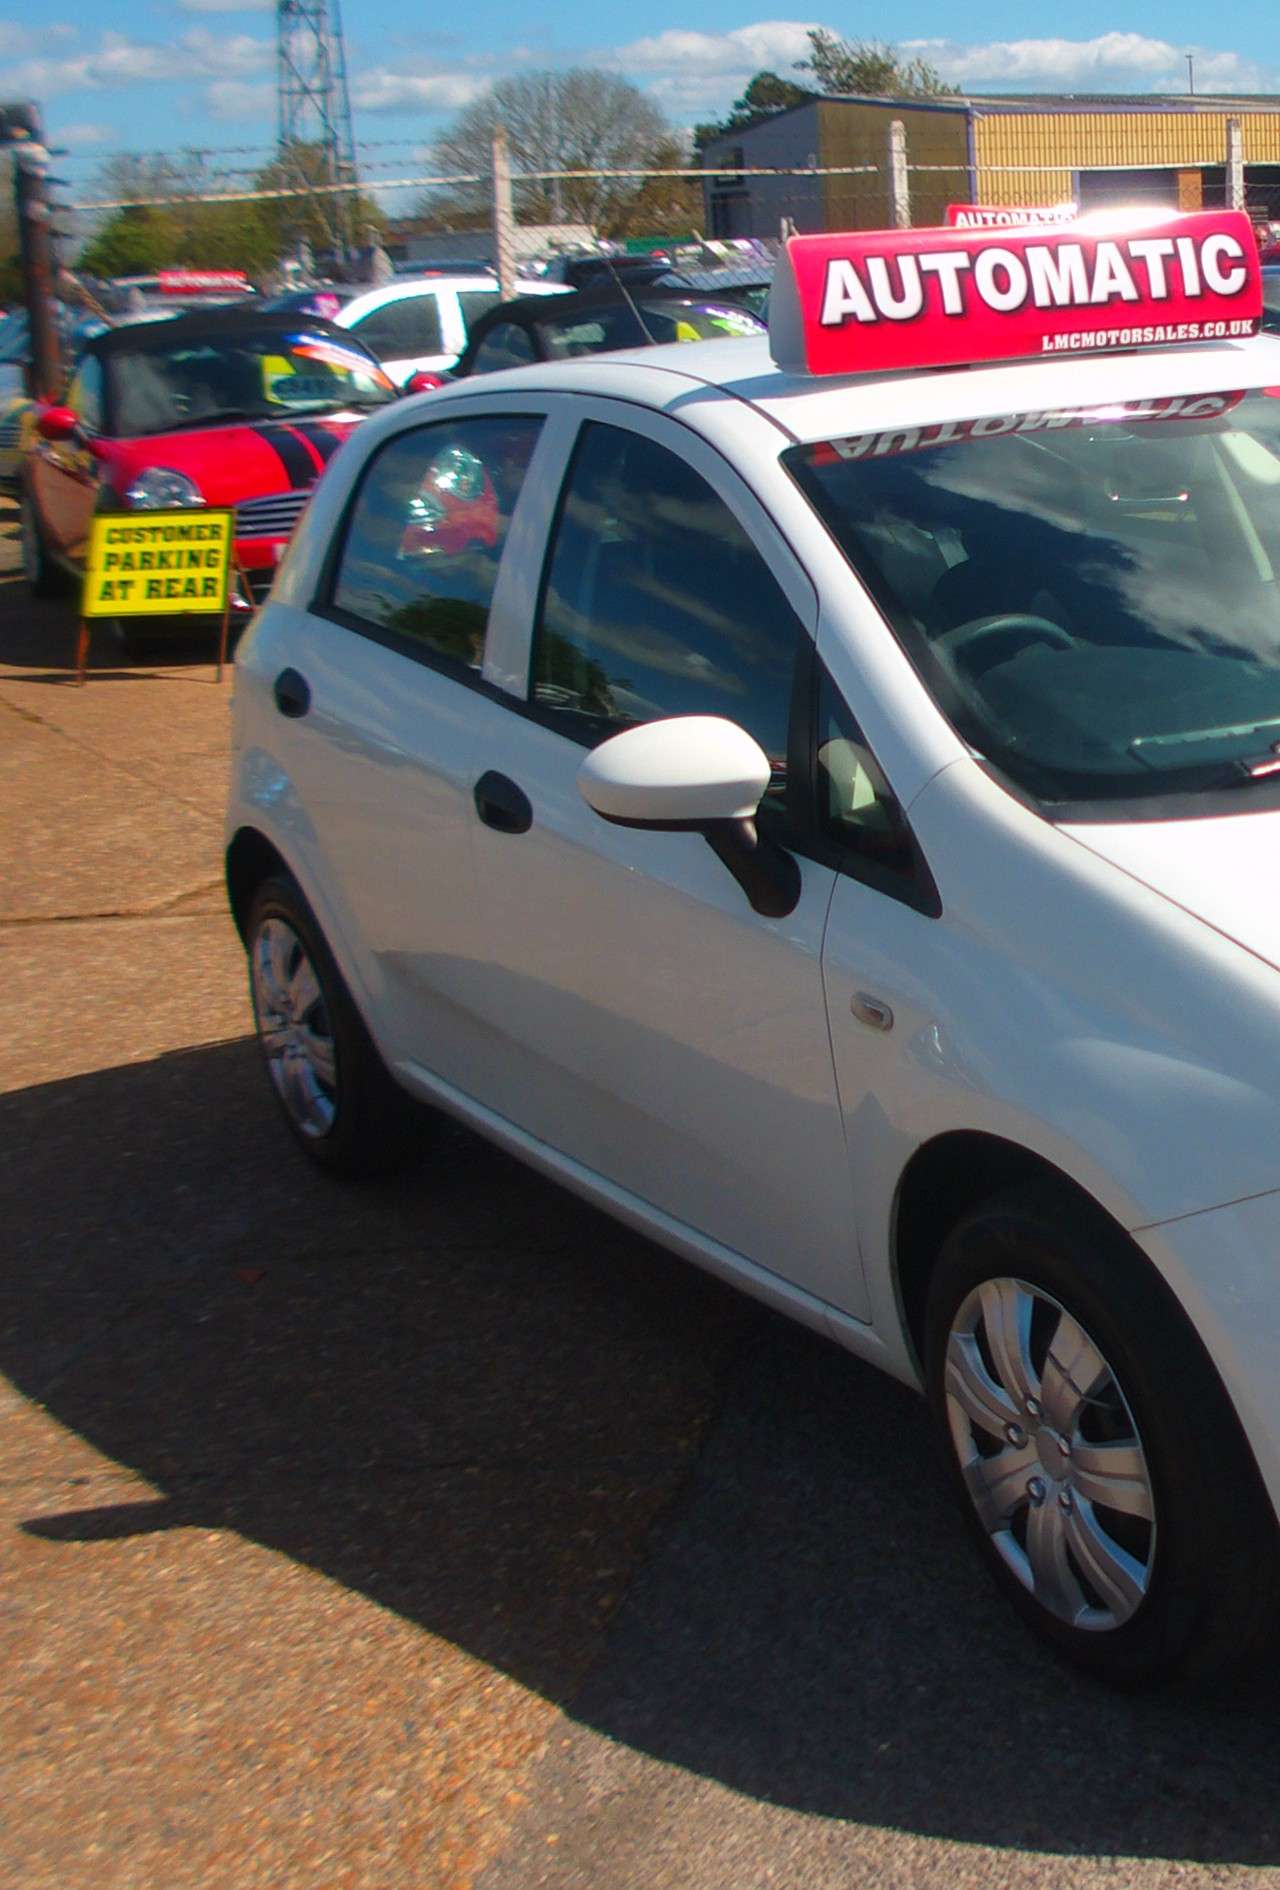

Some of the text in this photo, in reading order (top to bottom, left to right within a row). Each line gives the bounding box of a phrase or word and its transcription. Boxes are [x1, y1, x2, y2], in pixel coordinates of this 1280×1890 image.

[821, 234, 1247, 326] AUTOMATIC
[1042, 319, 1254, 351] LMCMOTORSALES.CO.UK
[105, 524, 222, 545] CUSTOMER
[103, 549, 221, 572] PARKING
[99, 577, 217, 601] AT REAR
